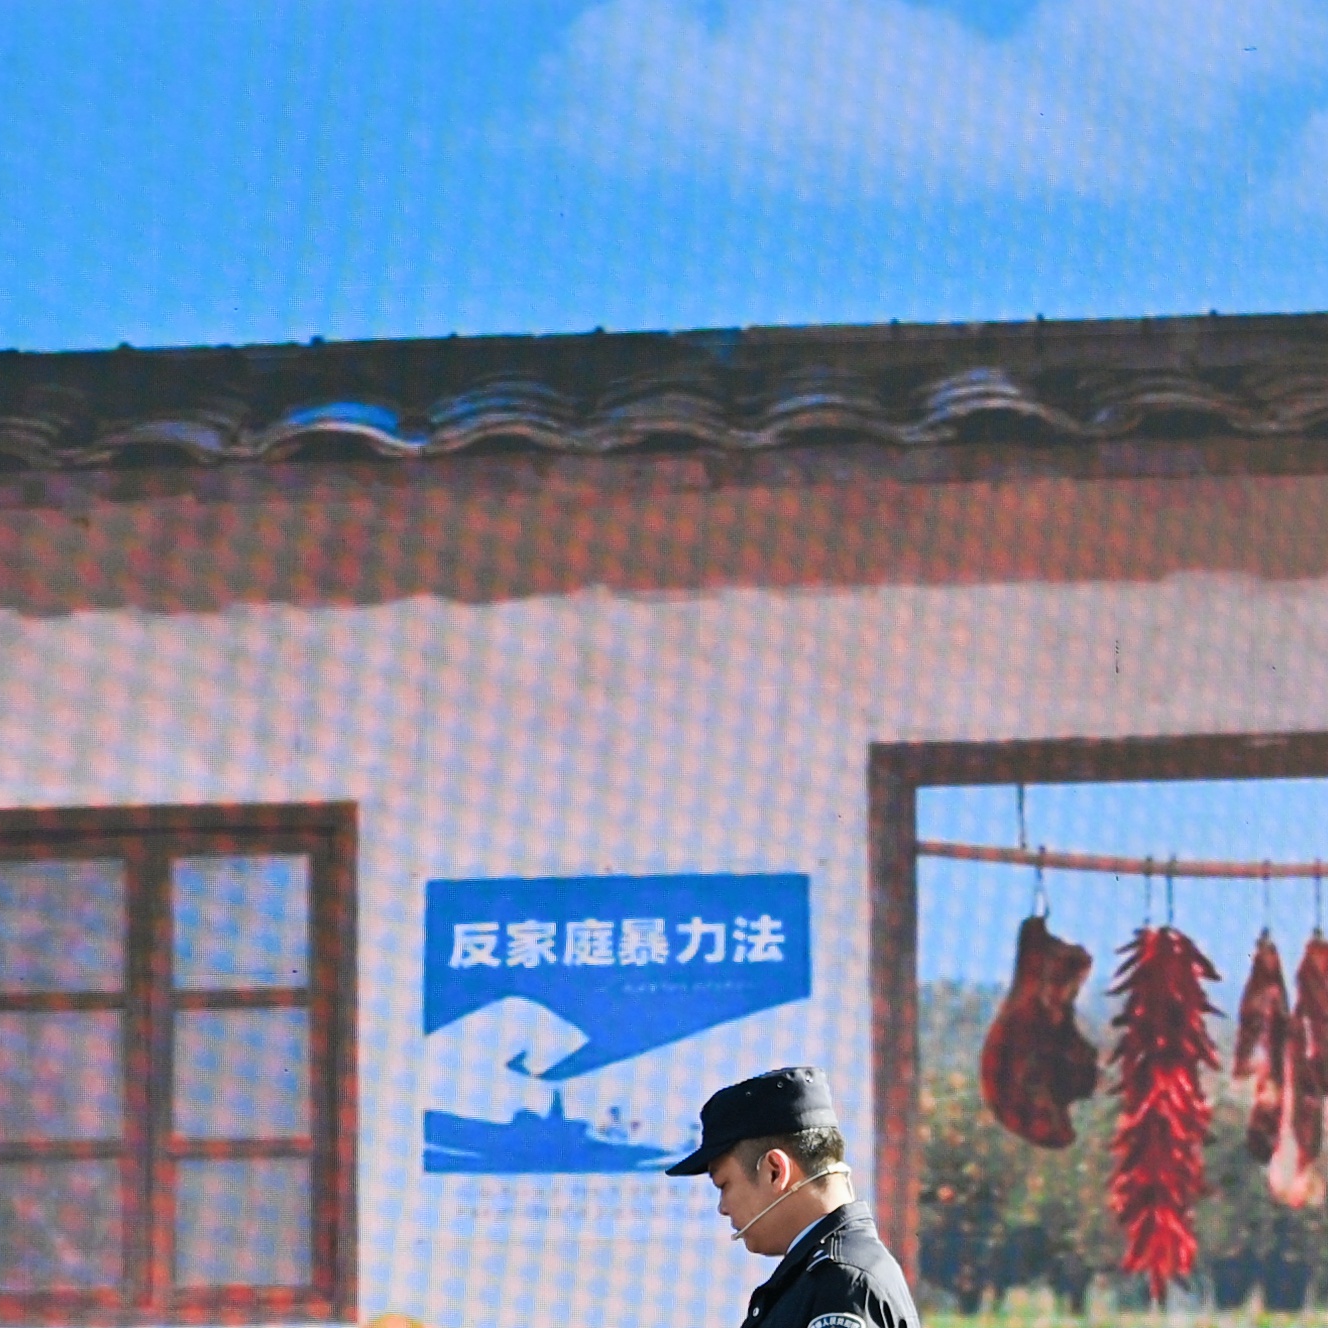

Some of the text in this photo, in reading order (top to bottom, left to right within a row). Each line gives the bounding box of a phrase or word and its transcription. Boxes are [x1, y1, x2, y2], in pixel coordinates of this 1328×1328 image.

[450, 915, 785, 968] 反家庭暴力法
